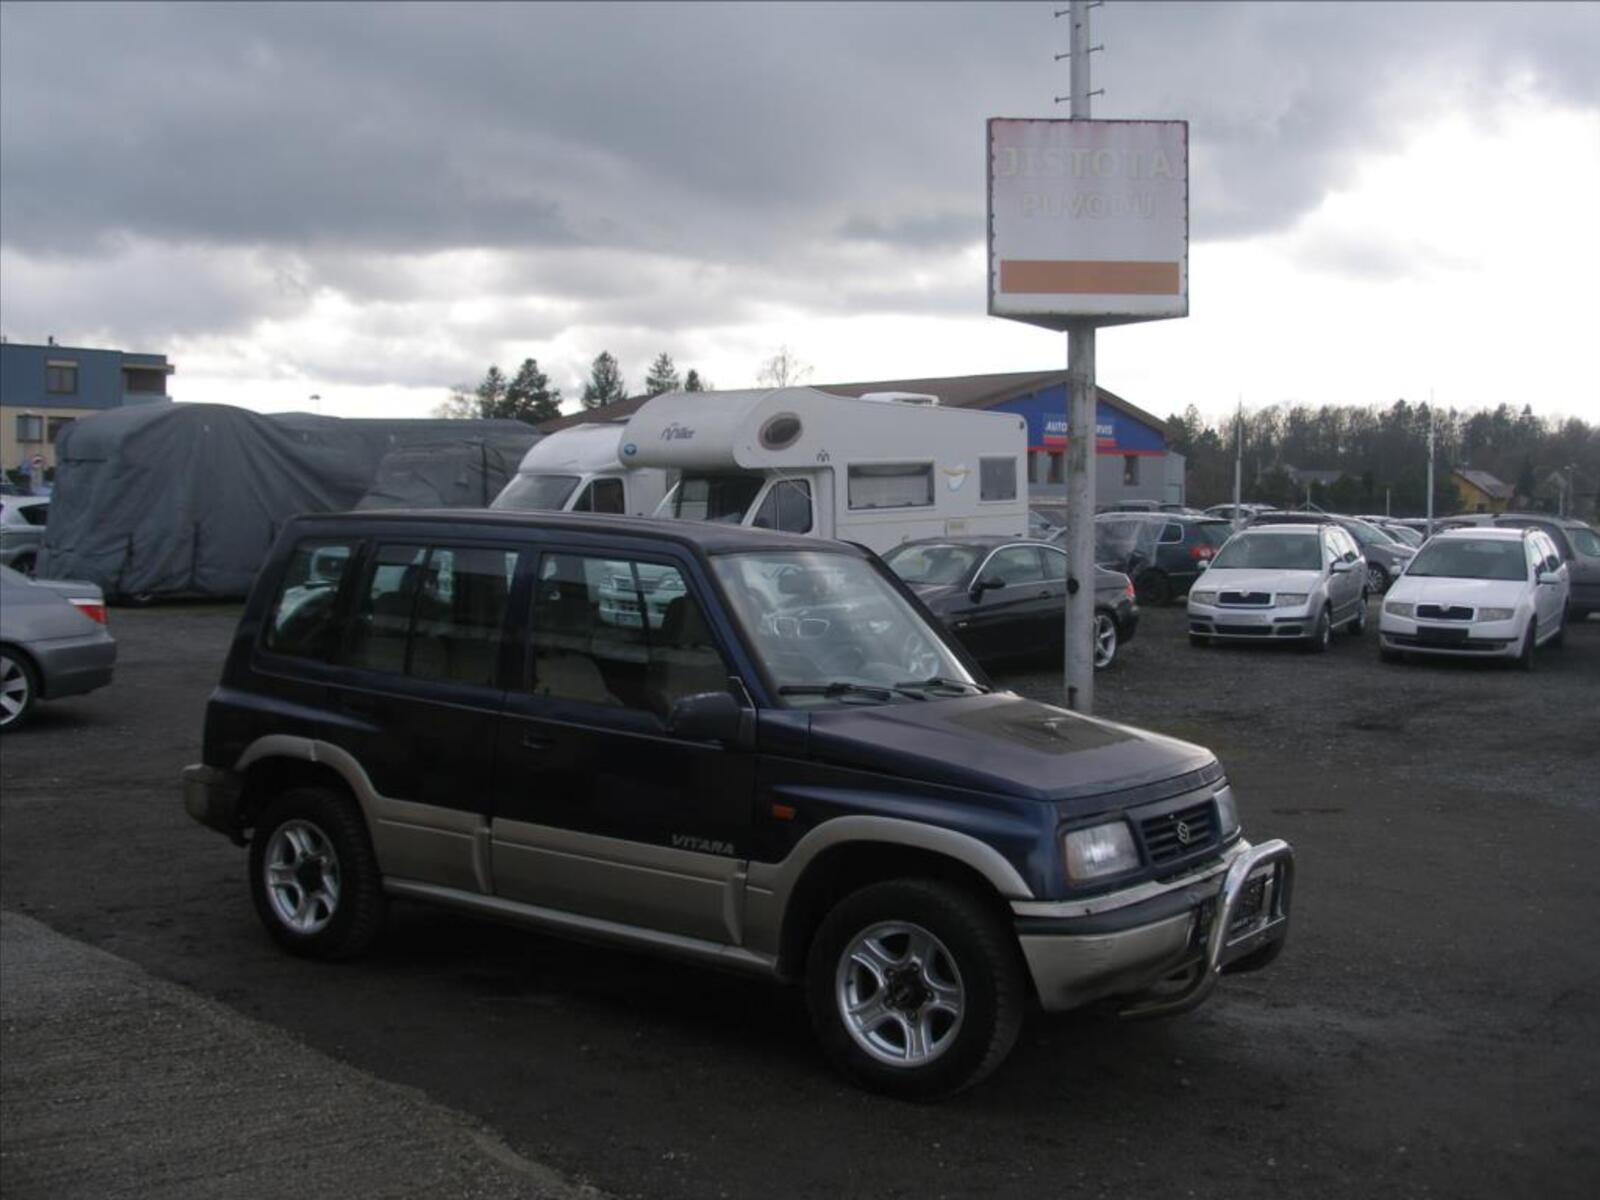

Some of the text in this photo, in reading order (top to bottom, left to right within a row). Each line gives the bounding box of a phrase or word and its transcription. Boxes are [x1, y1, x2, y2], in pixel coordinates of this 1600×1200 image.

[1000, 146, 1173, 178] JISTOTA
[1044, 420, 1068, 433] AUTO
[671, 834, 734, 855] VITARA
